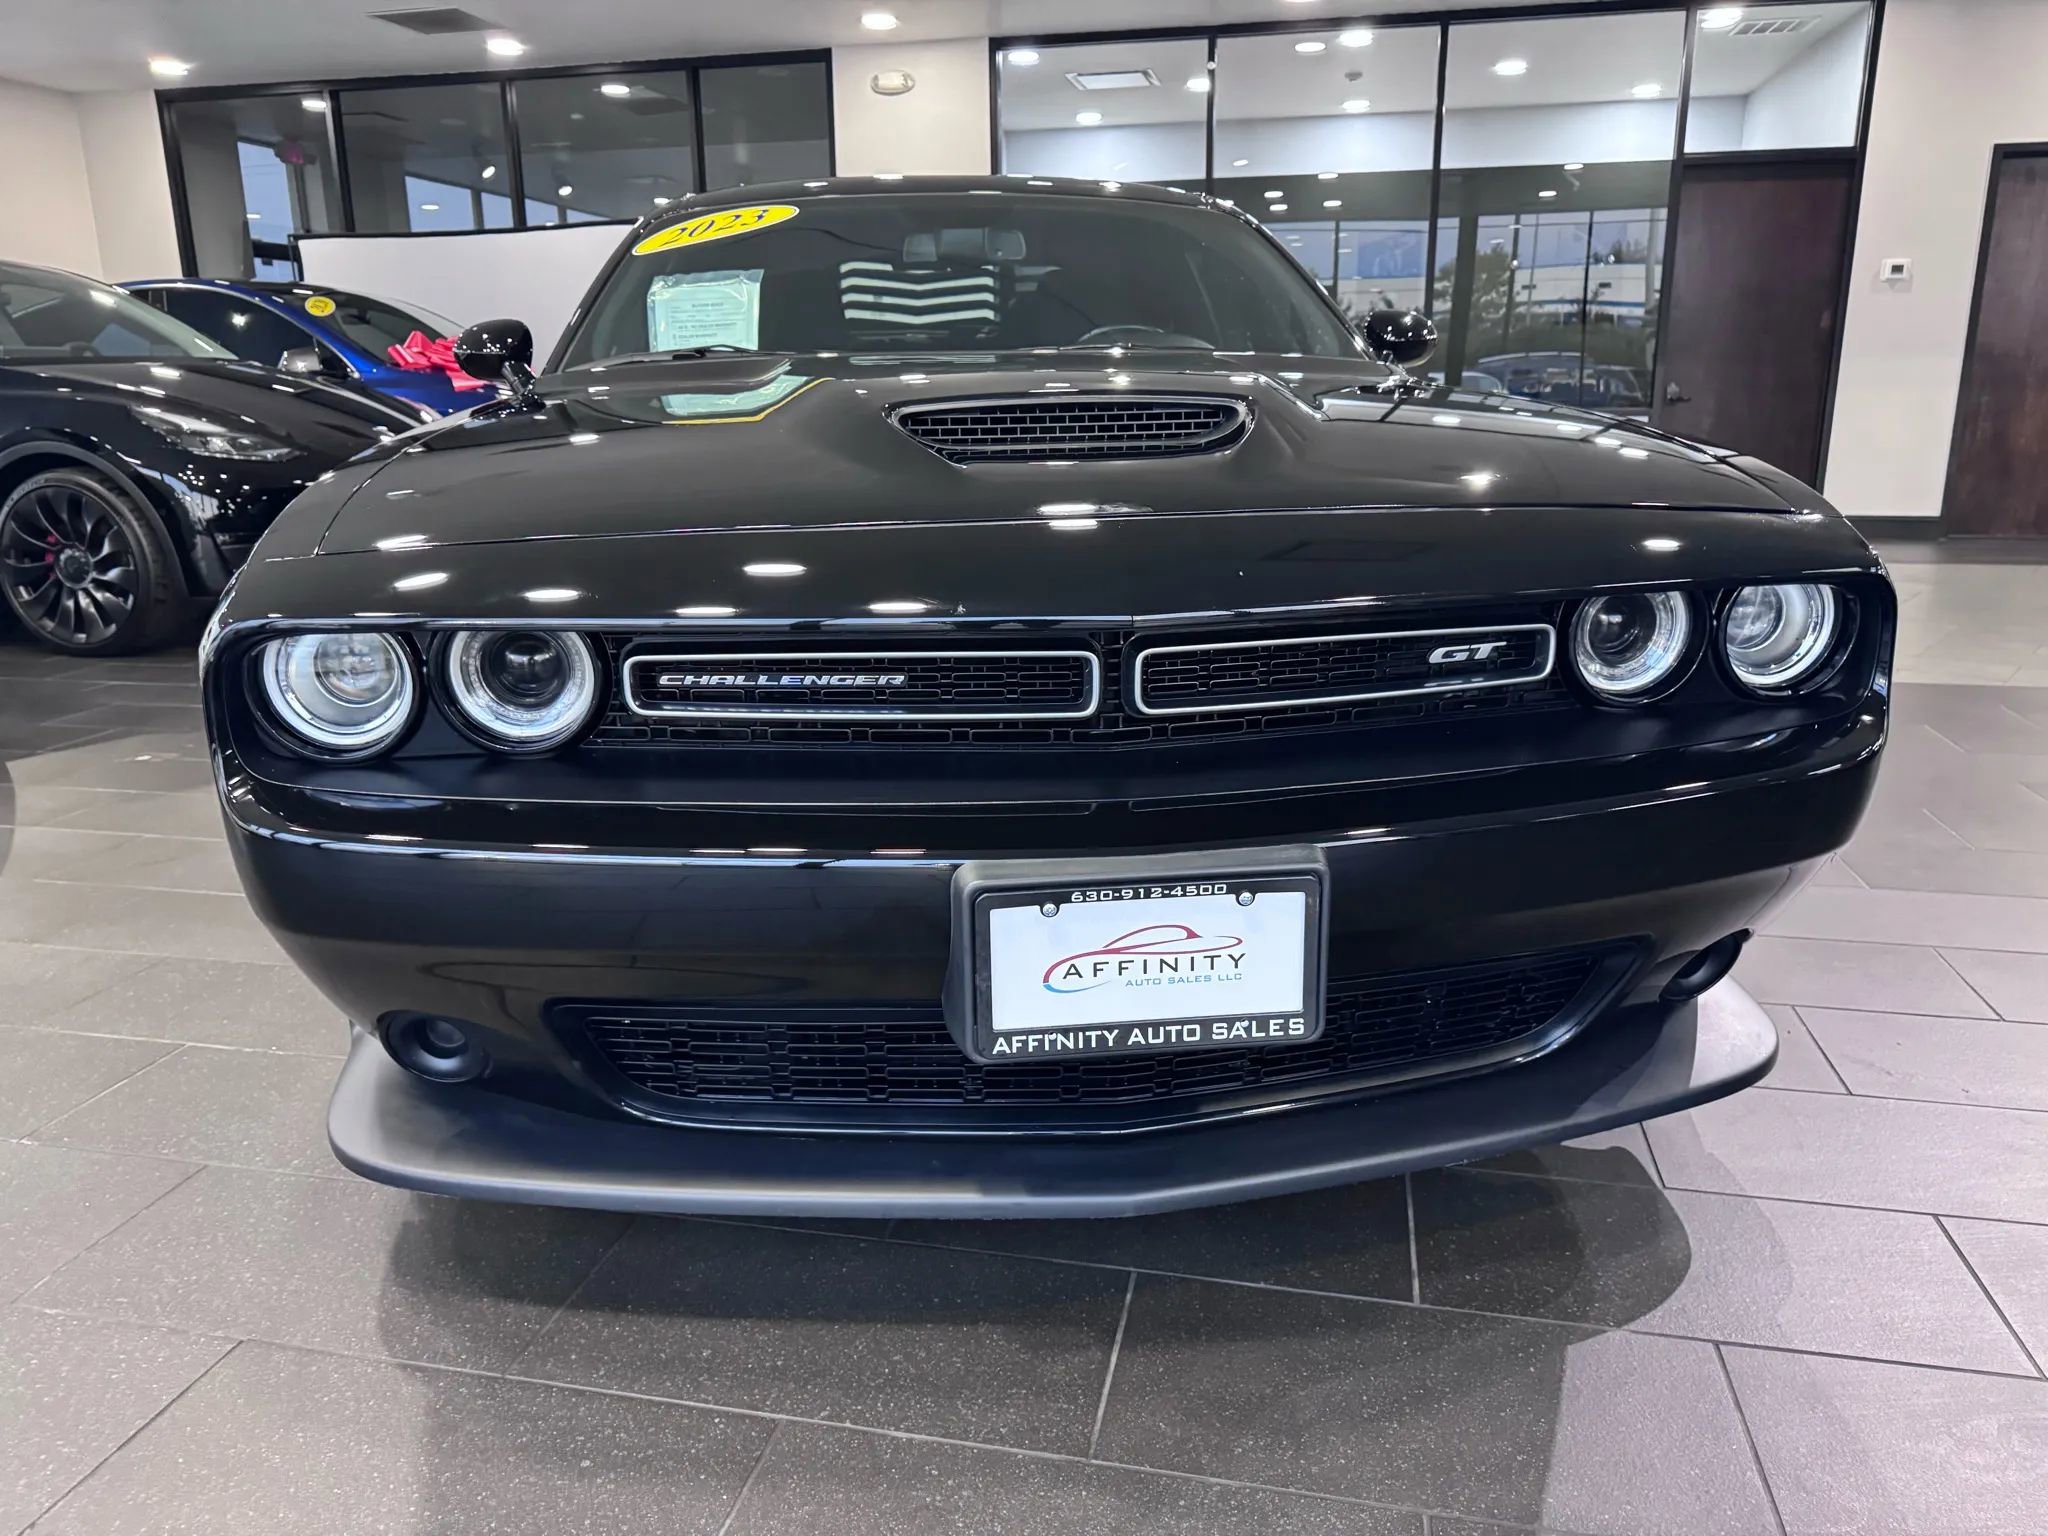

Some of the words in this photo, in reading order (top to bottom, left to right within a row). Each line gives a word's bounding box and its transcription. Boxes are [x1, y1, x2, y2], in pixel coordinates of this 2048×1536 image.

[657, 208, 770, 248] 2023
[1429, 641, 1507, 664] GT
[658, 673, 906, 687] CHALLENGER
[1070, 883, 1228, 903] 630-912-4500
[1062, 953, 1247, 980] AFFINITY
[1125, 977, 1162, 987] AUTO
[1167, 974, 1212, 985] SALES
[1217, 973, 1243, 981] LLC
[992, 1028, 1120, 1055] AFFINITY
[1127, 1023, 1201, 1046] AUTO
[1211, 1017, 1306, 1040] SALES
